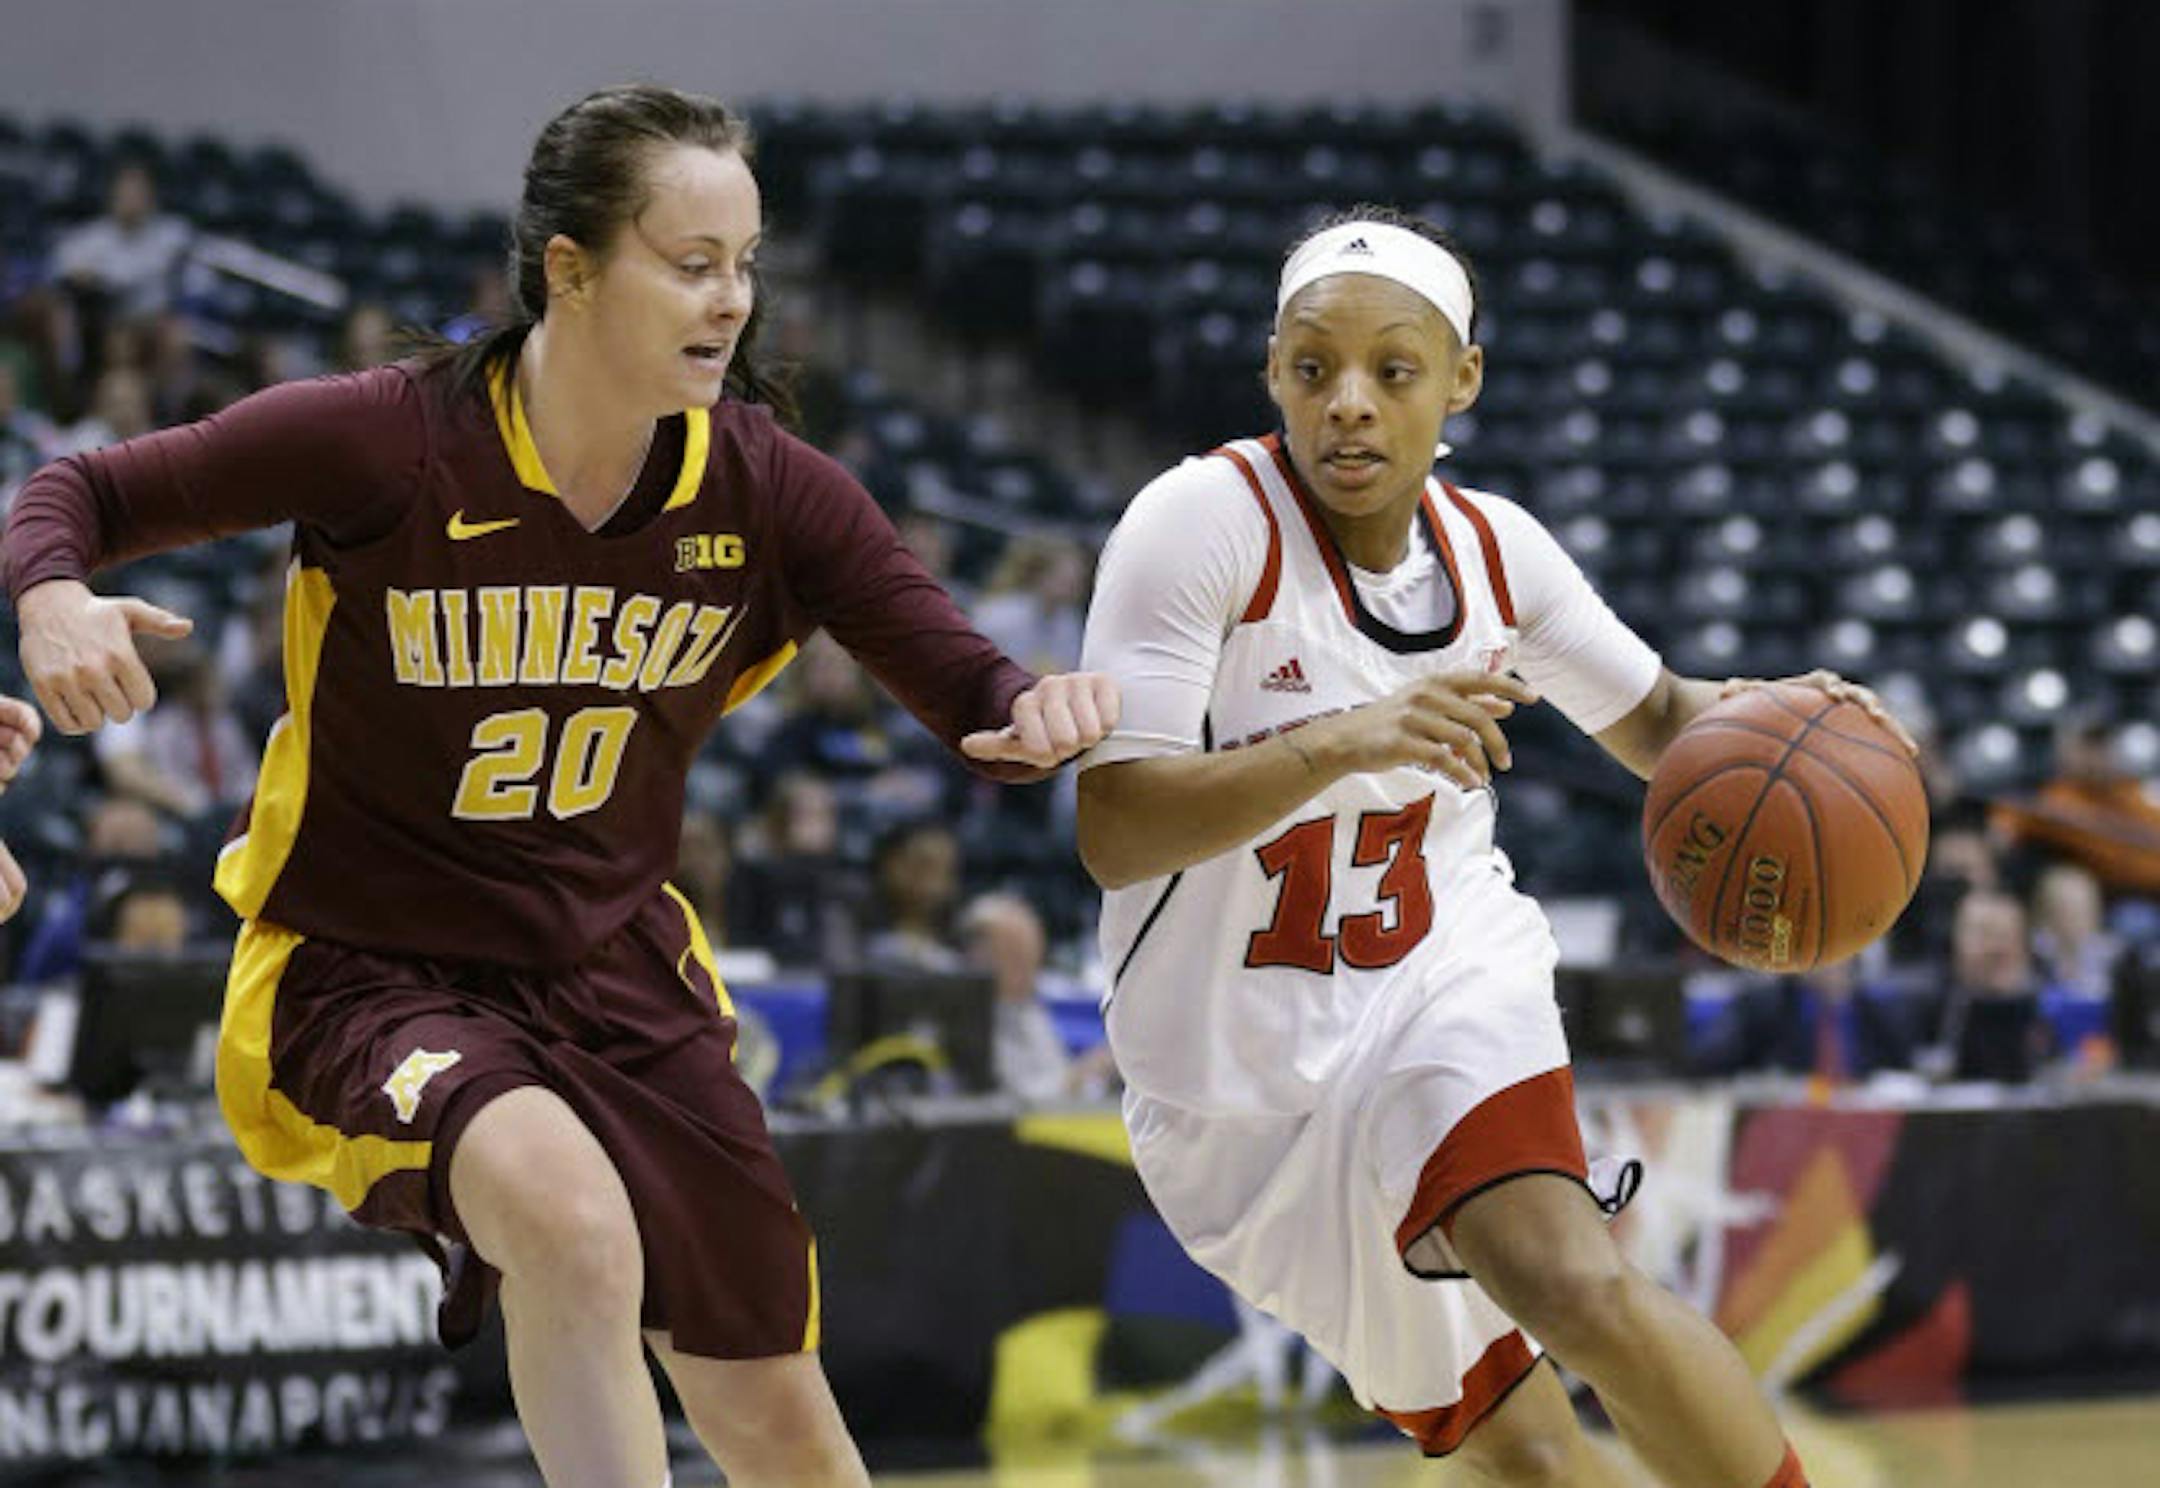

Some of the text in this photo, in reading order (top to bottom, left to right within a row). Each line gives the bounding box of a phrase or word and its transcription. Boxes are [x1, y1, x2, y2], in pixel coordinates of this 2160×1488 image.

[386, 585, 750, 692] MINNESOT
[451, 706, 639, 821] 20
[1243, 790, 1437, 975] 13
[0, 1163, 368, 1242] ASKETB
[0, 1253, 448, 1362] TOURNAMEN
